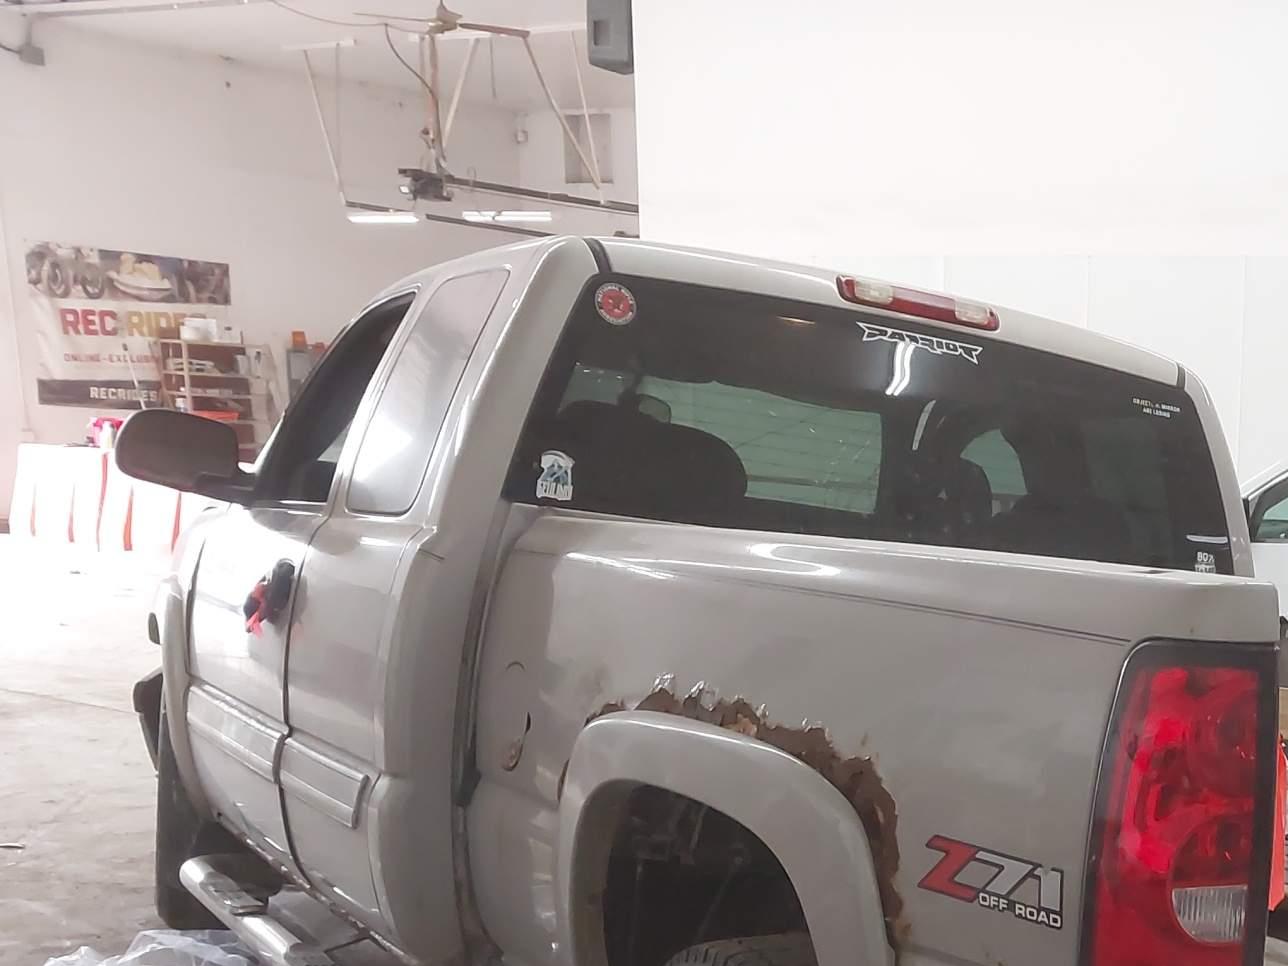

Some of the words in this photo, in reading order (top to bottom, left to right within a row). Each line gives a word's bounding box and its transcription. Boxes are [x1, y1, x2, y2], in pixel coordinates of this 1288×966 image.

[60, 308, 118, 336] REC
[856, 321, 983, 364] PATRIOT
[917, 834, 1064, 911] Z71
[978, 892, 1009, 911] OFF
[1015, 903, 1062, 928] ROAD
